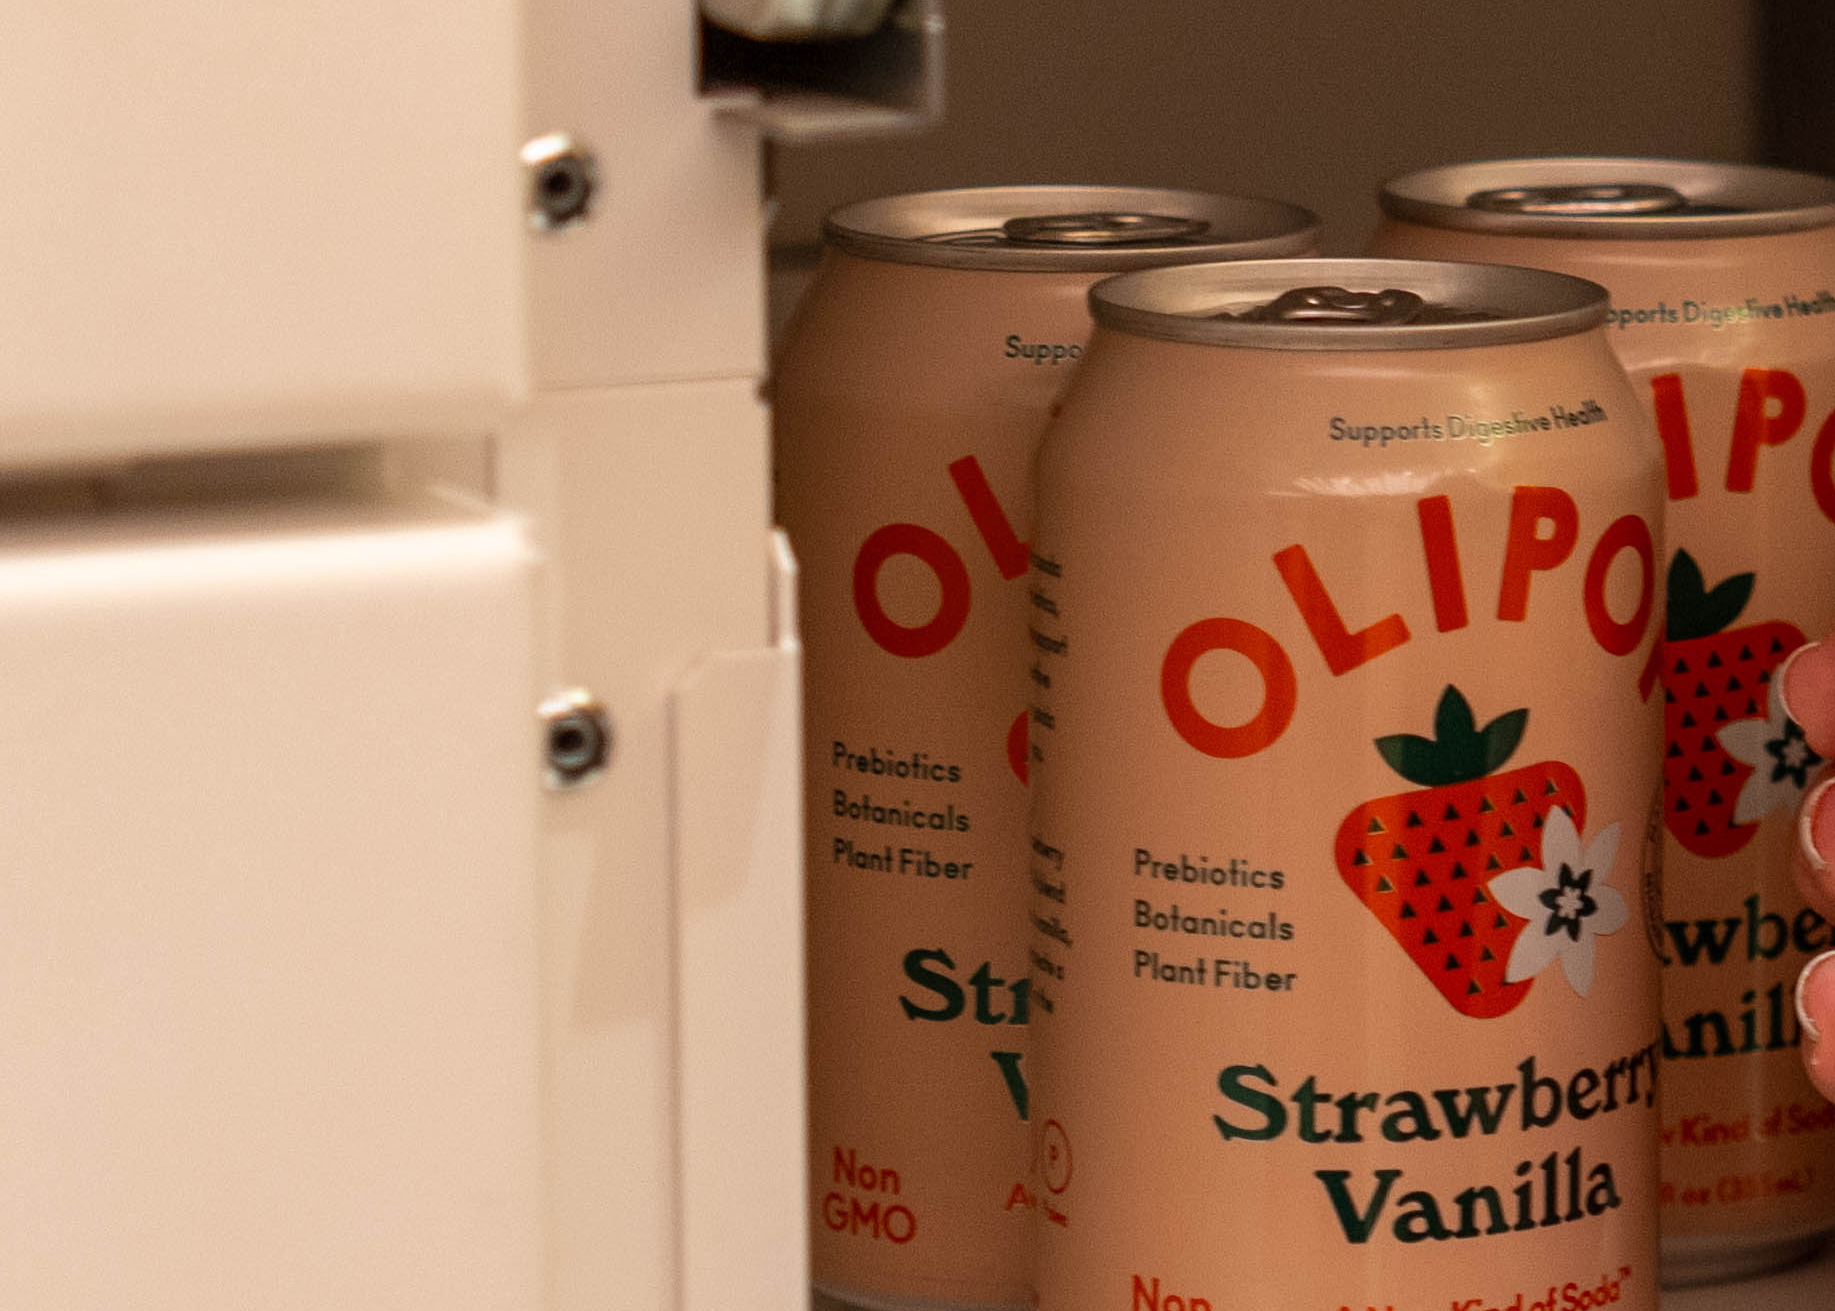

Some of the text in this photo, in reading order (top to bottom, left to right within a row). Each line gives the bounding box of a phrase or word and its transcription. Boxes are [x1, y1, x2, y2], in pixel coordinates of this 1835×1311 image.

[1005, 334, 1083, 366] Suppo
[1328, 415, 1444, 449] Supports
[1447, 410, 1550, 448] Digestive
[1161, 485, 1660, 760] OLIPO
[833, 741, 961, 783] Prebiotics
[833, 790, 969, 832] Botanicals
[833, 837, 973, 880] Plant Fiber
[1133, 847, 1285, 891] Prebiotics
[1133, 898, 1295, 941] Botanicals
[1133, 949, 1298, 991] Plant Fiber
[832, 1145, 901, 1195] Non
[1314, 1145, 1622, 1245] Vanilla
[822, 1191, 918, 1246] GMO
